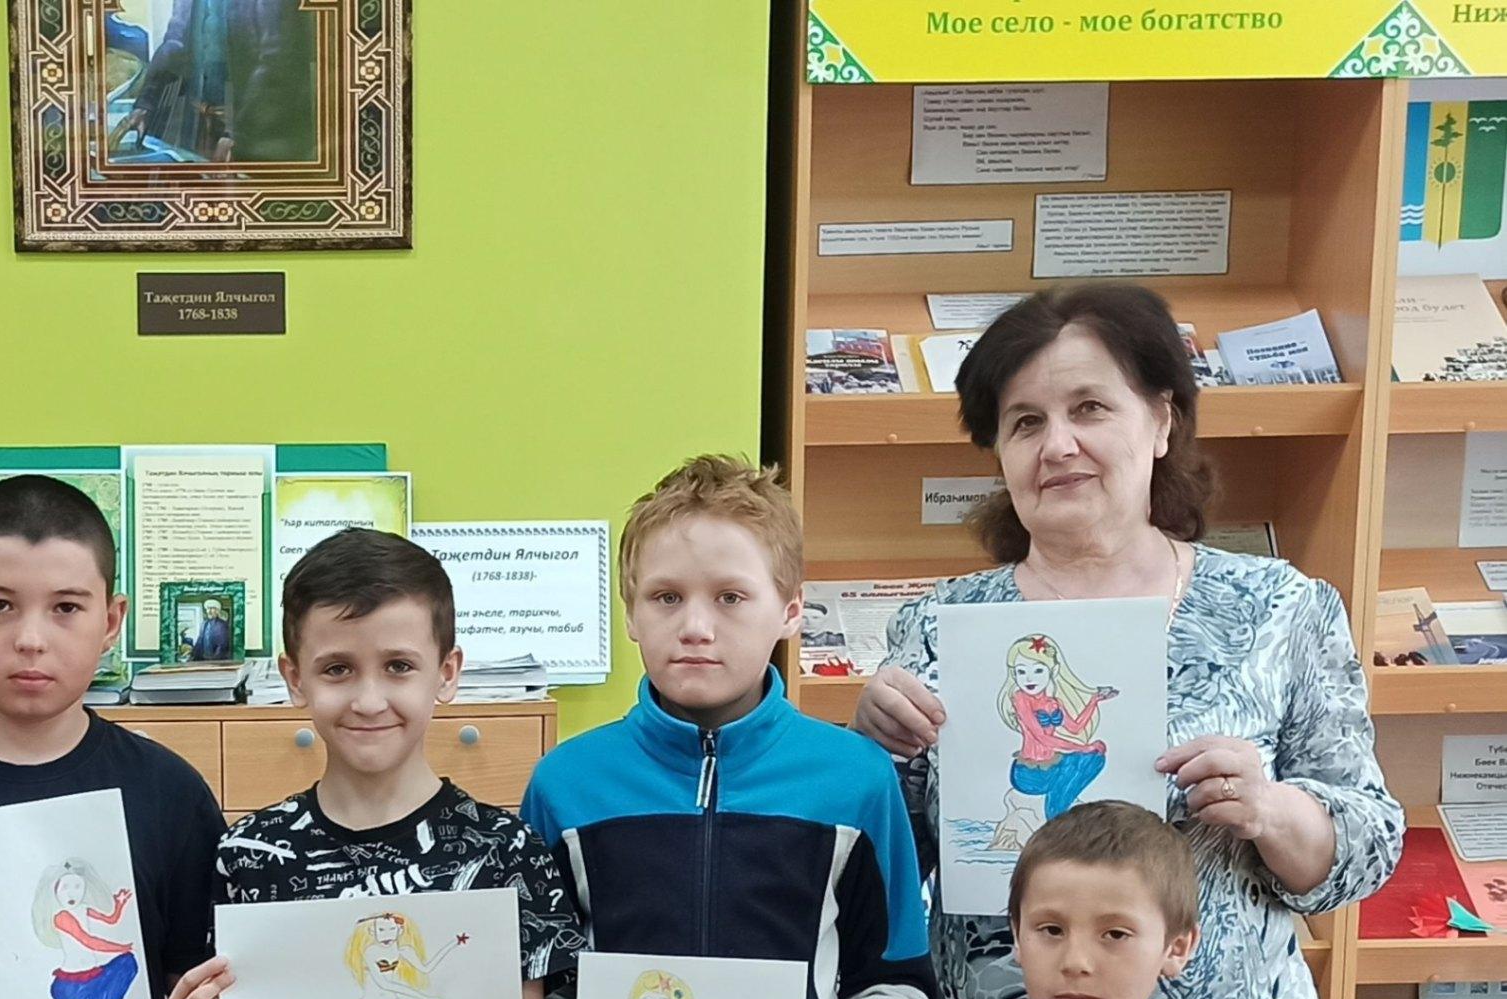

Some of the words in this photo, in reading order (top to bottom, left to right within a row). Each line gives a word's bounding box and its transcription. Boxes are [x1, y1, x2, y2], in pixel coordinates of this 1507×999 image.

[926, 11, 983, 34] Мое
[991, 14, 1054, 33] село
[1079, 12, 1132, 32] мое
[1141, 8, 1283, 31] богатство
[144, 291, 212, 306] Таҗетдин
[215, 291, 276, 304] Ялчыгол
[178, 308, 238, 320] 1768-1838
[431, 548, 511, 564] Таҗетдин
[515, 549, 579, 561] Ялчыгол
[547, 622, 584, 633] табиб
